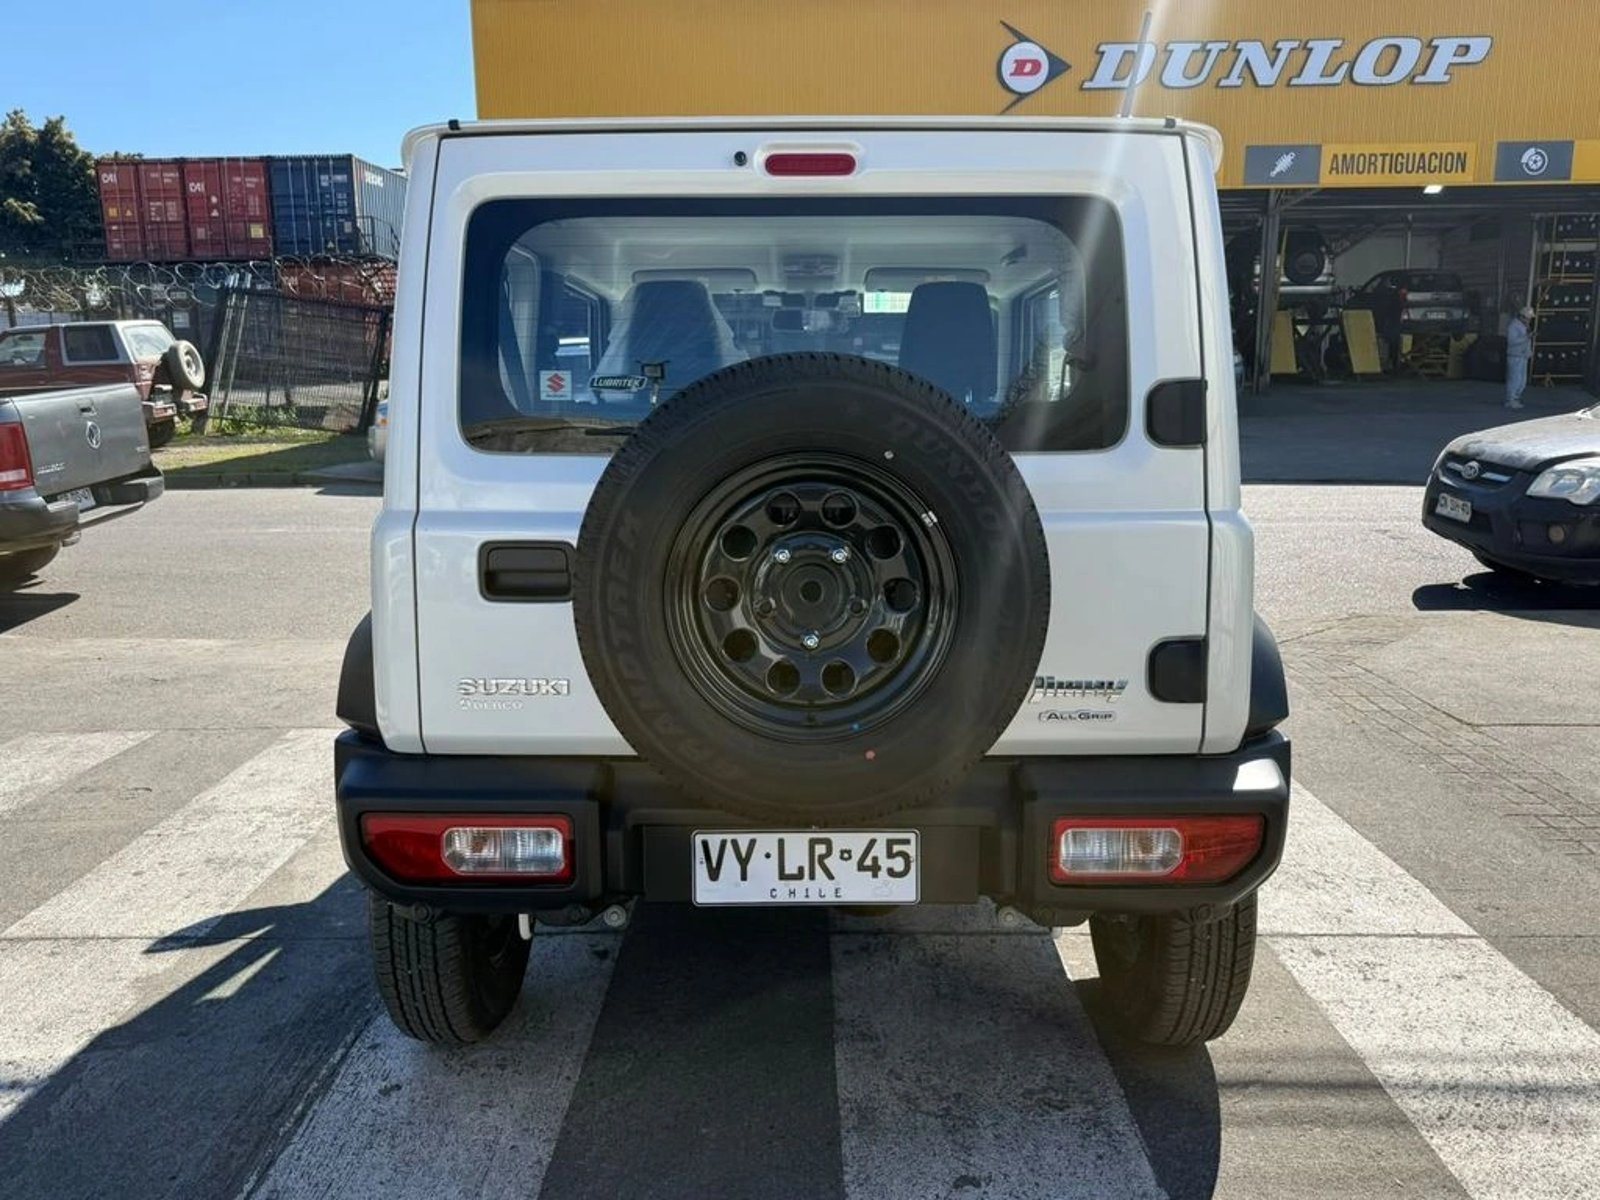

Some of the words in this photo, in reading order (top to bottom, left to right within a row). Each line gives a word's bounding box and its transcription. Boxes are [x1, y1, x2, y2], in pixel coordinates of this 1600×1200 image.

[1009, 58, 1042, 76] D
[1081, 36, 1493, 91] DUNLOP
[1328, 150, 1467, 176] AMORTIGUACION
[459, 677, 571, 696] SUZUKI
[769, 887, 843, 899] CHILE
